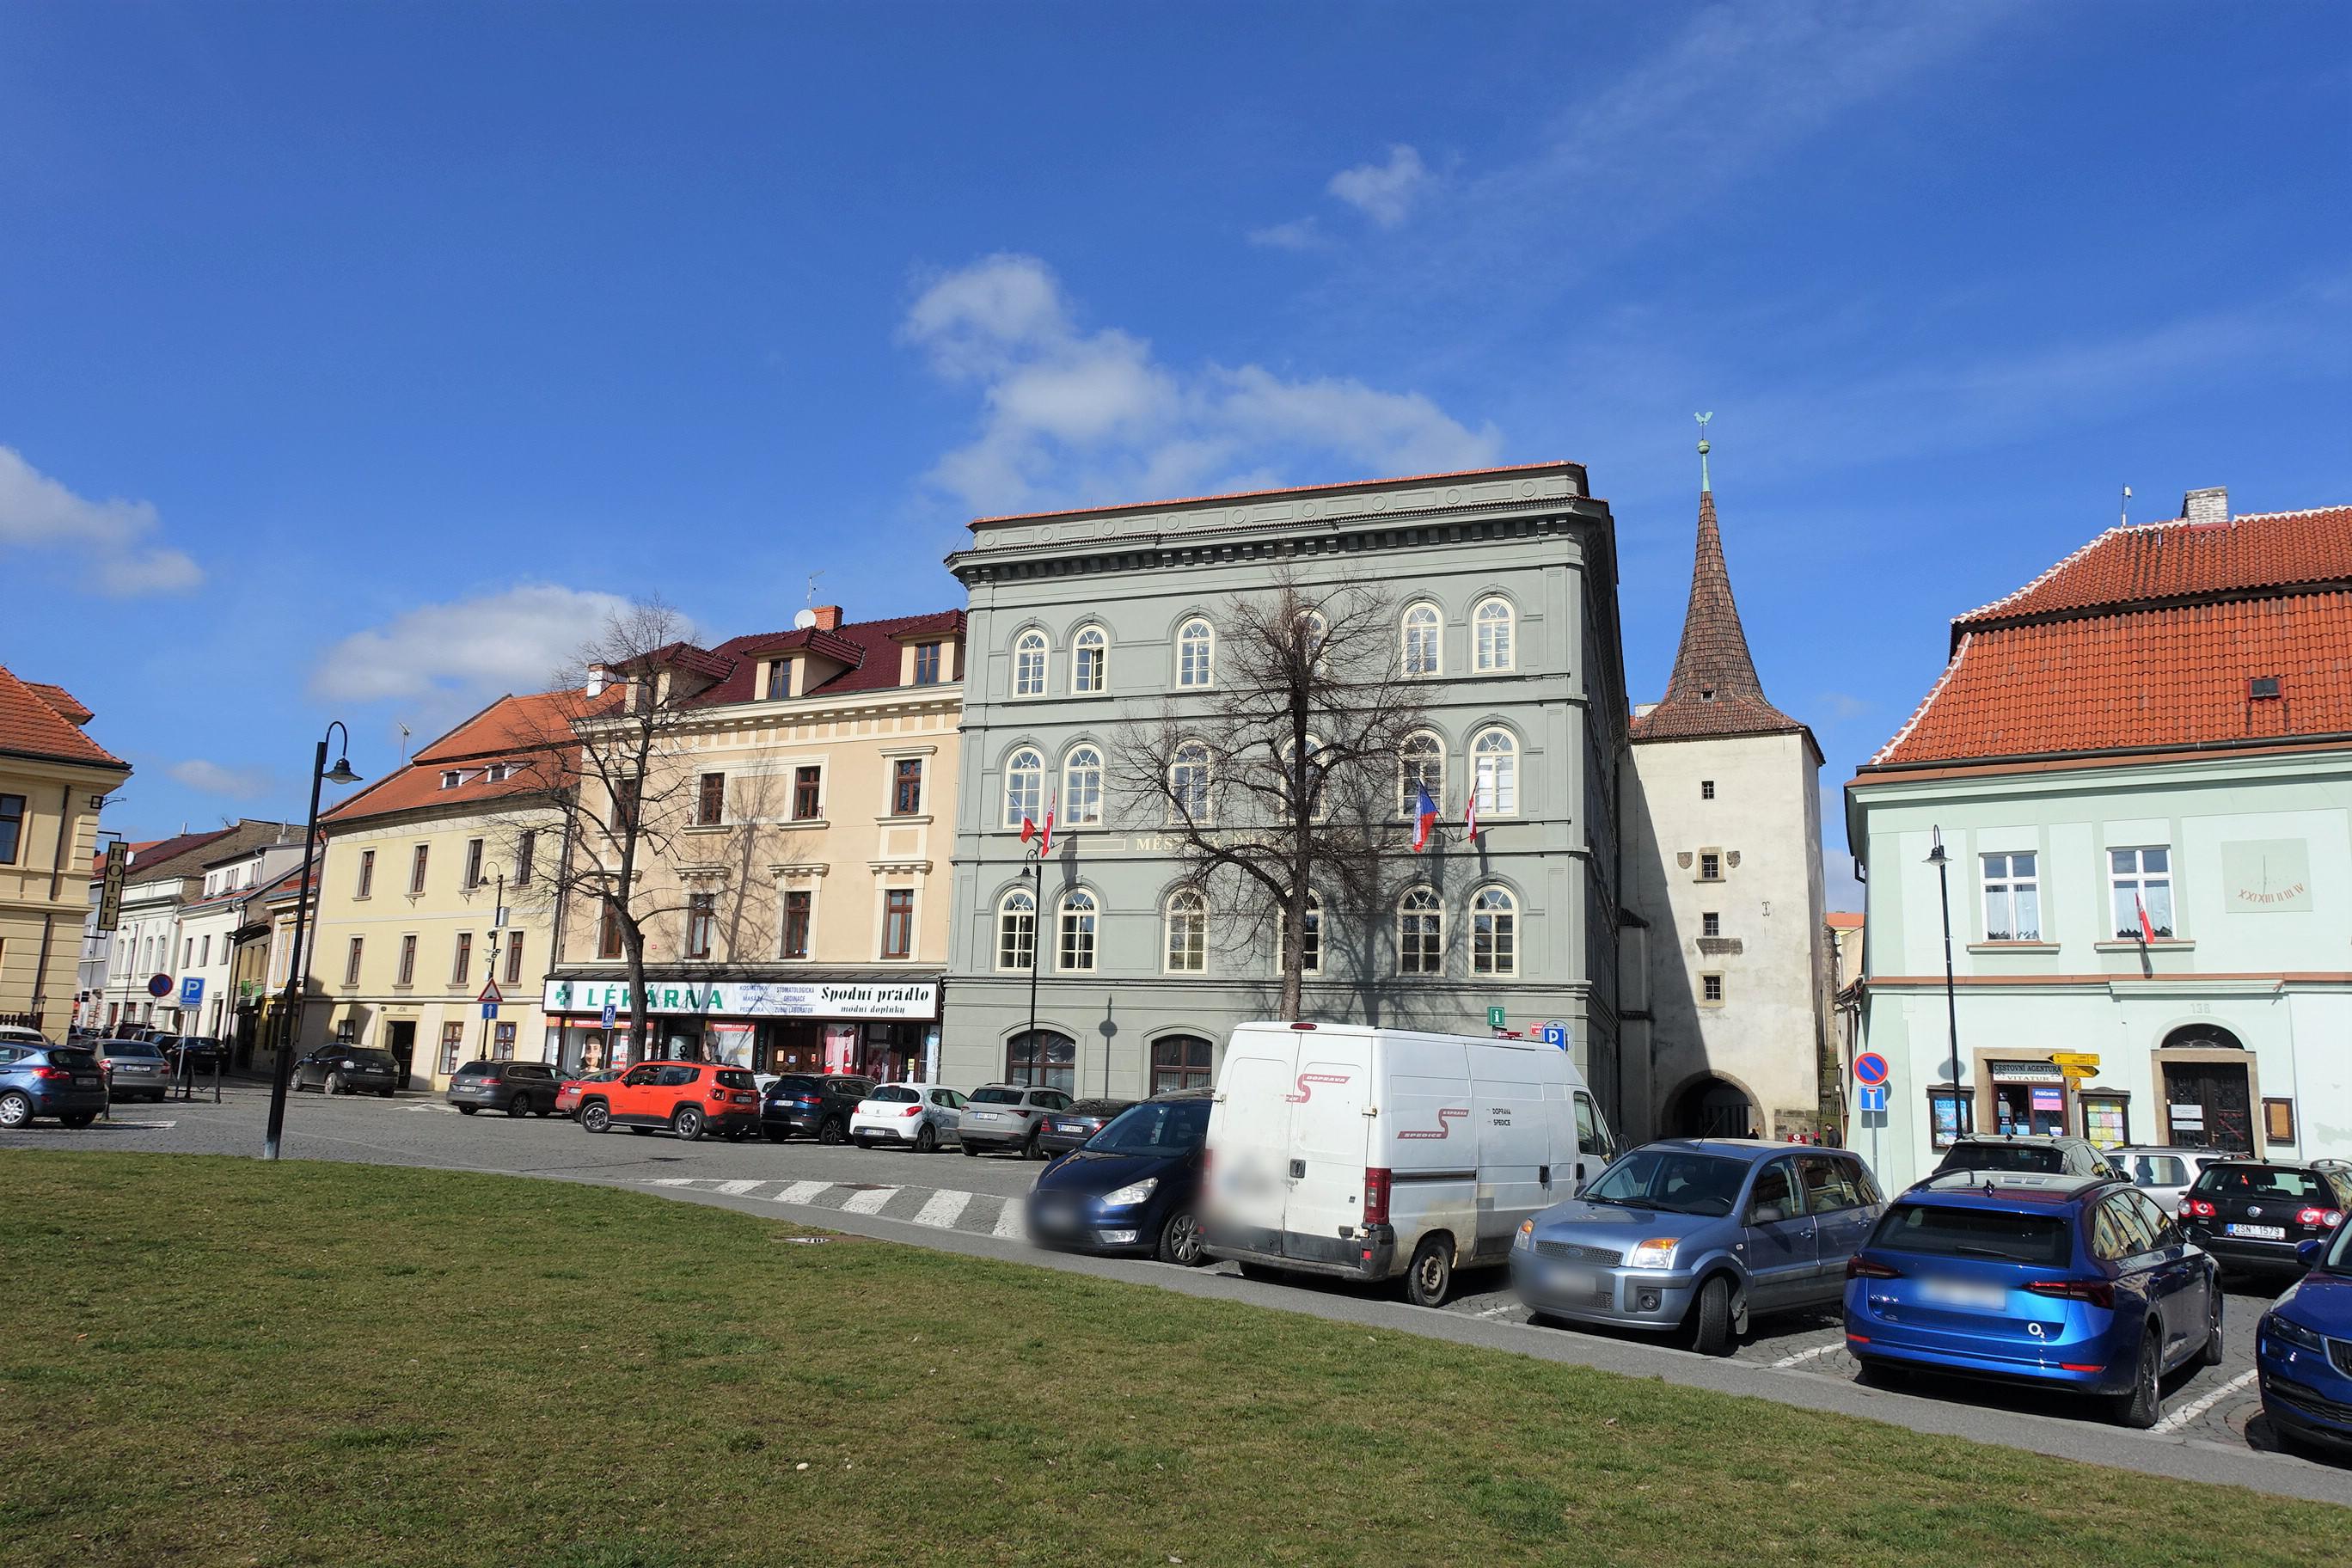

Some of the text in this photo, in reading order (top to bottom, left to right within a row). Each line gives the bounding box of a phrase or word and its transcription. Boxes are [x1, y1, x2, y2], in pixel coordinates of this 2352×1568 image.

[103, 848, 124, 925] HOTEL
[586, 983, 723, 1009] LÉKÁRNA
[821, 986, 929, 1003] Spodní prádlo
[2190, 1003, 2211, 1014] 138
[1994, 1063, 2026, 1073] CESTOVNÍ
[2027, 1063, 2062, 1074] AGENTURA
[1306, 1075, 1346, 1083] DOPRAVA
[2235, 1224, 2251, 1234] 2SN
